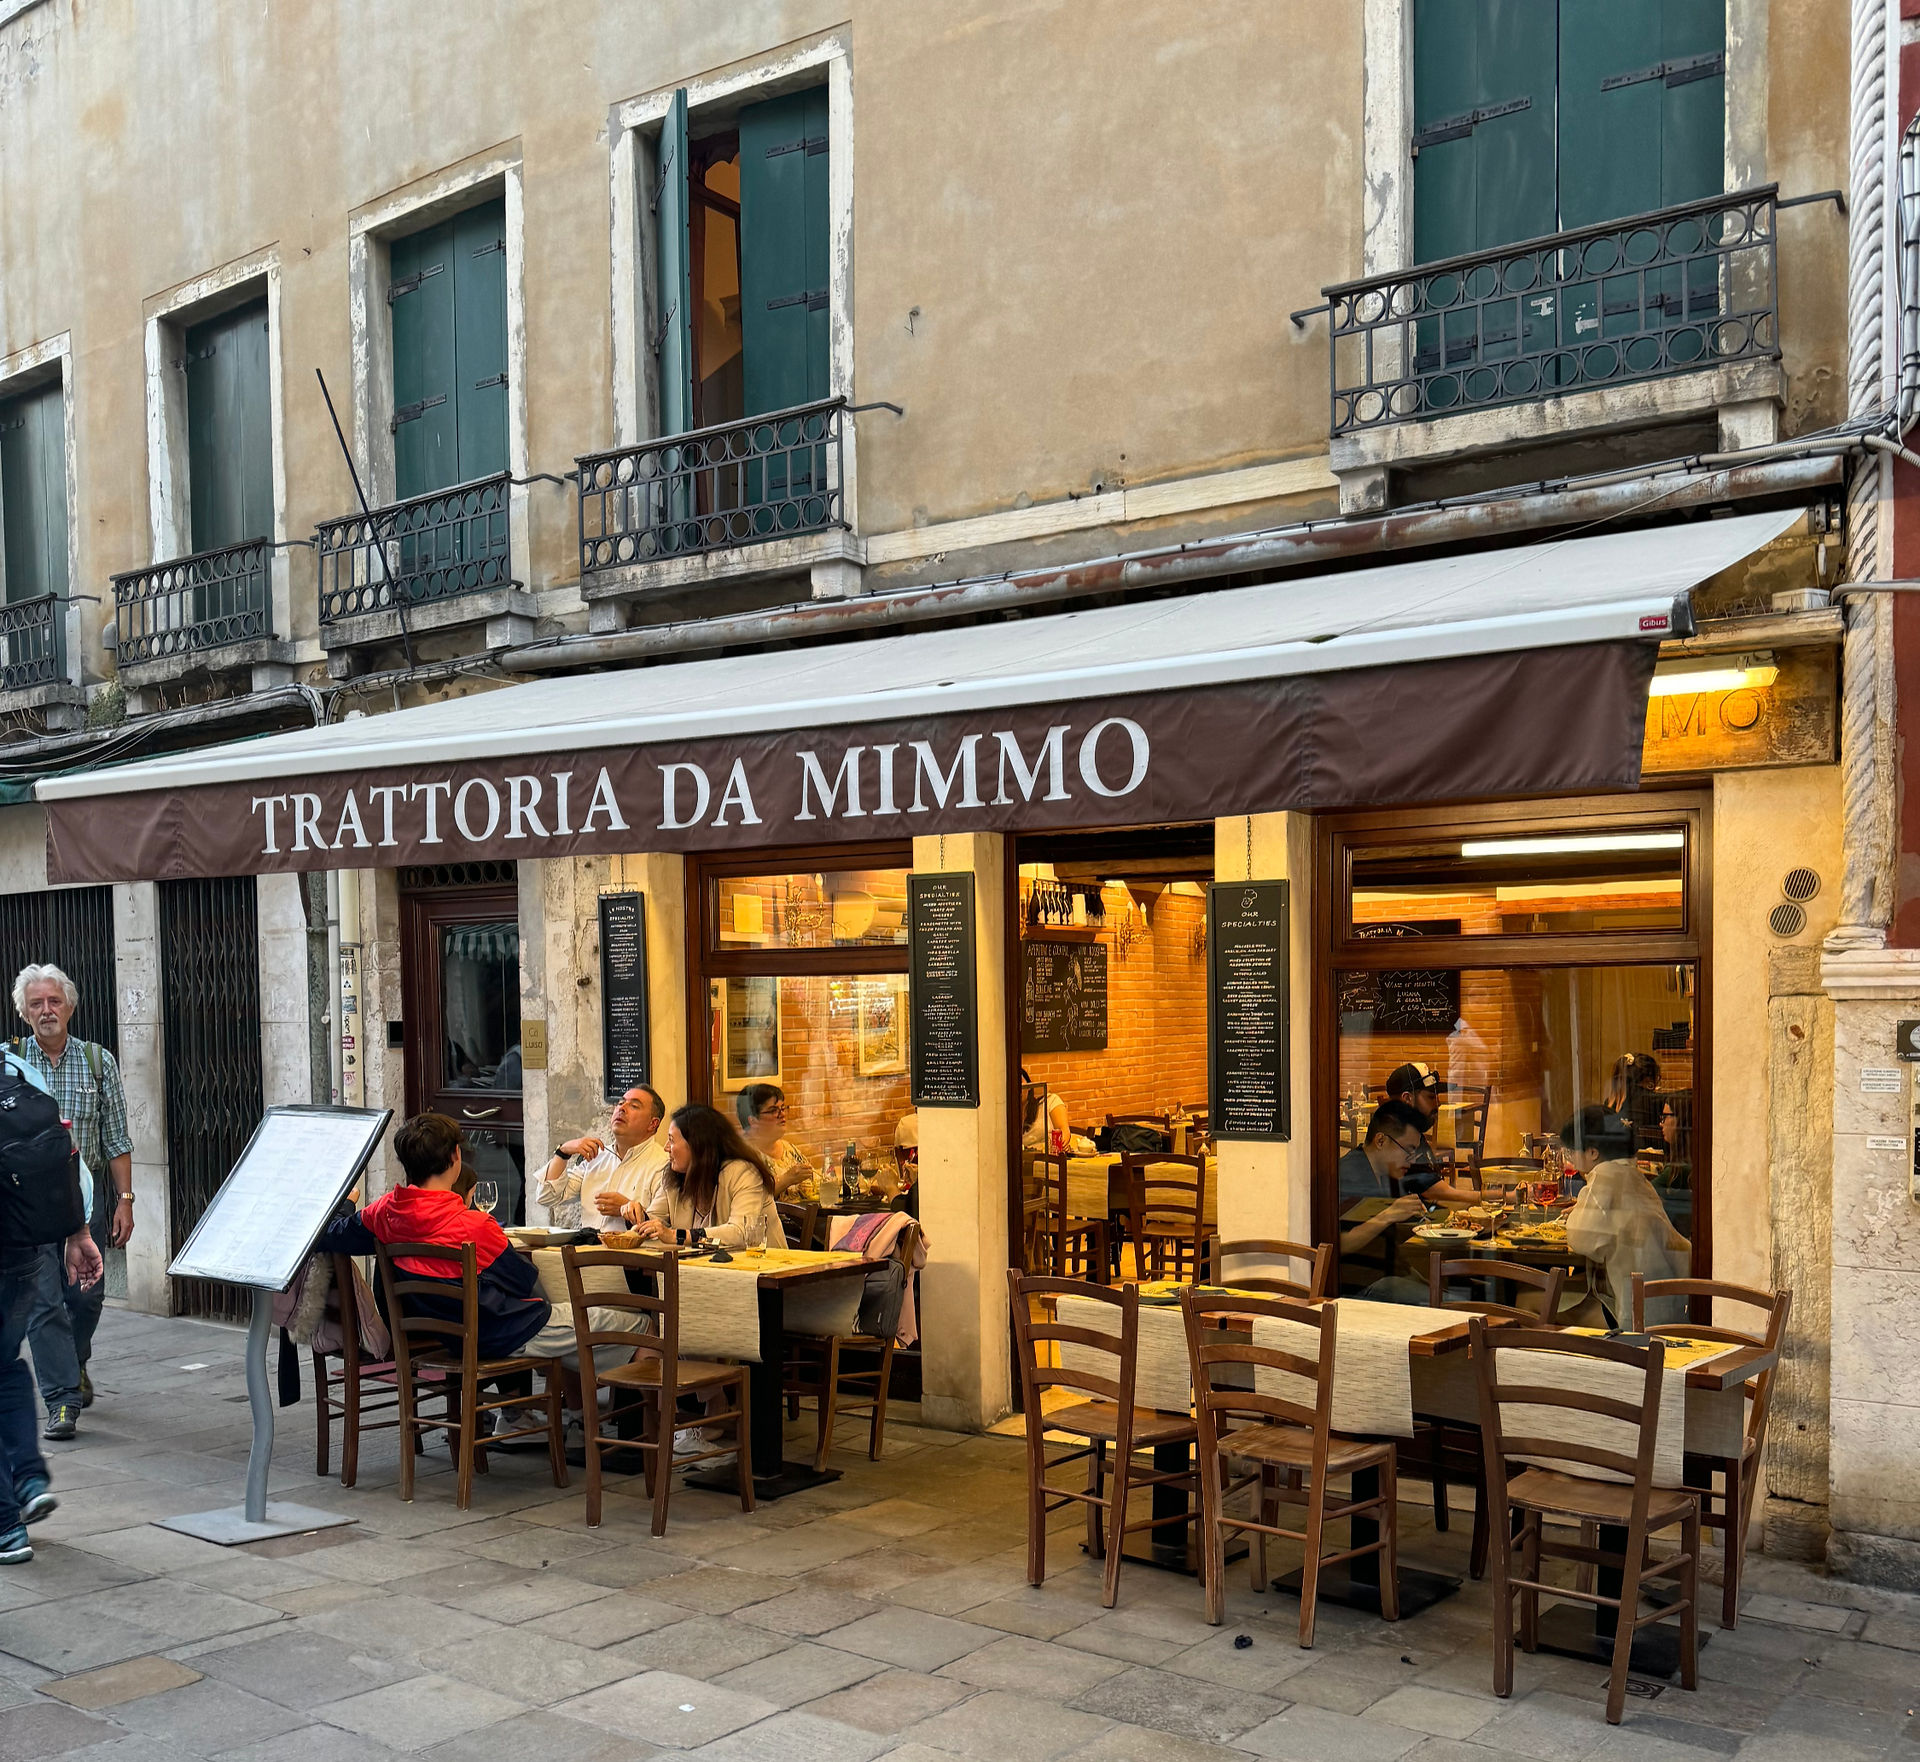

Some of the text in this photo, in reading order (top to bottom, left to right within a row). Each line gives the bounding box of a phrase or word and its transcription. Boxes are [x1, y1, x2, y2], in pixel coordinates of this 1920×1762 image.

[251, 717, 1151, 854] TRATTORIA DA MIMMO
